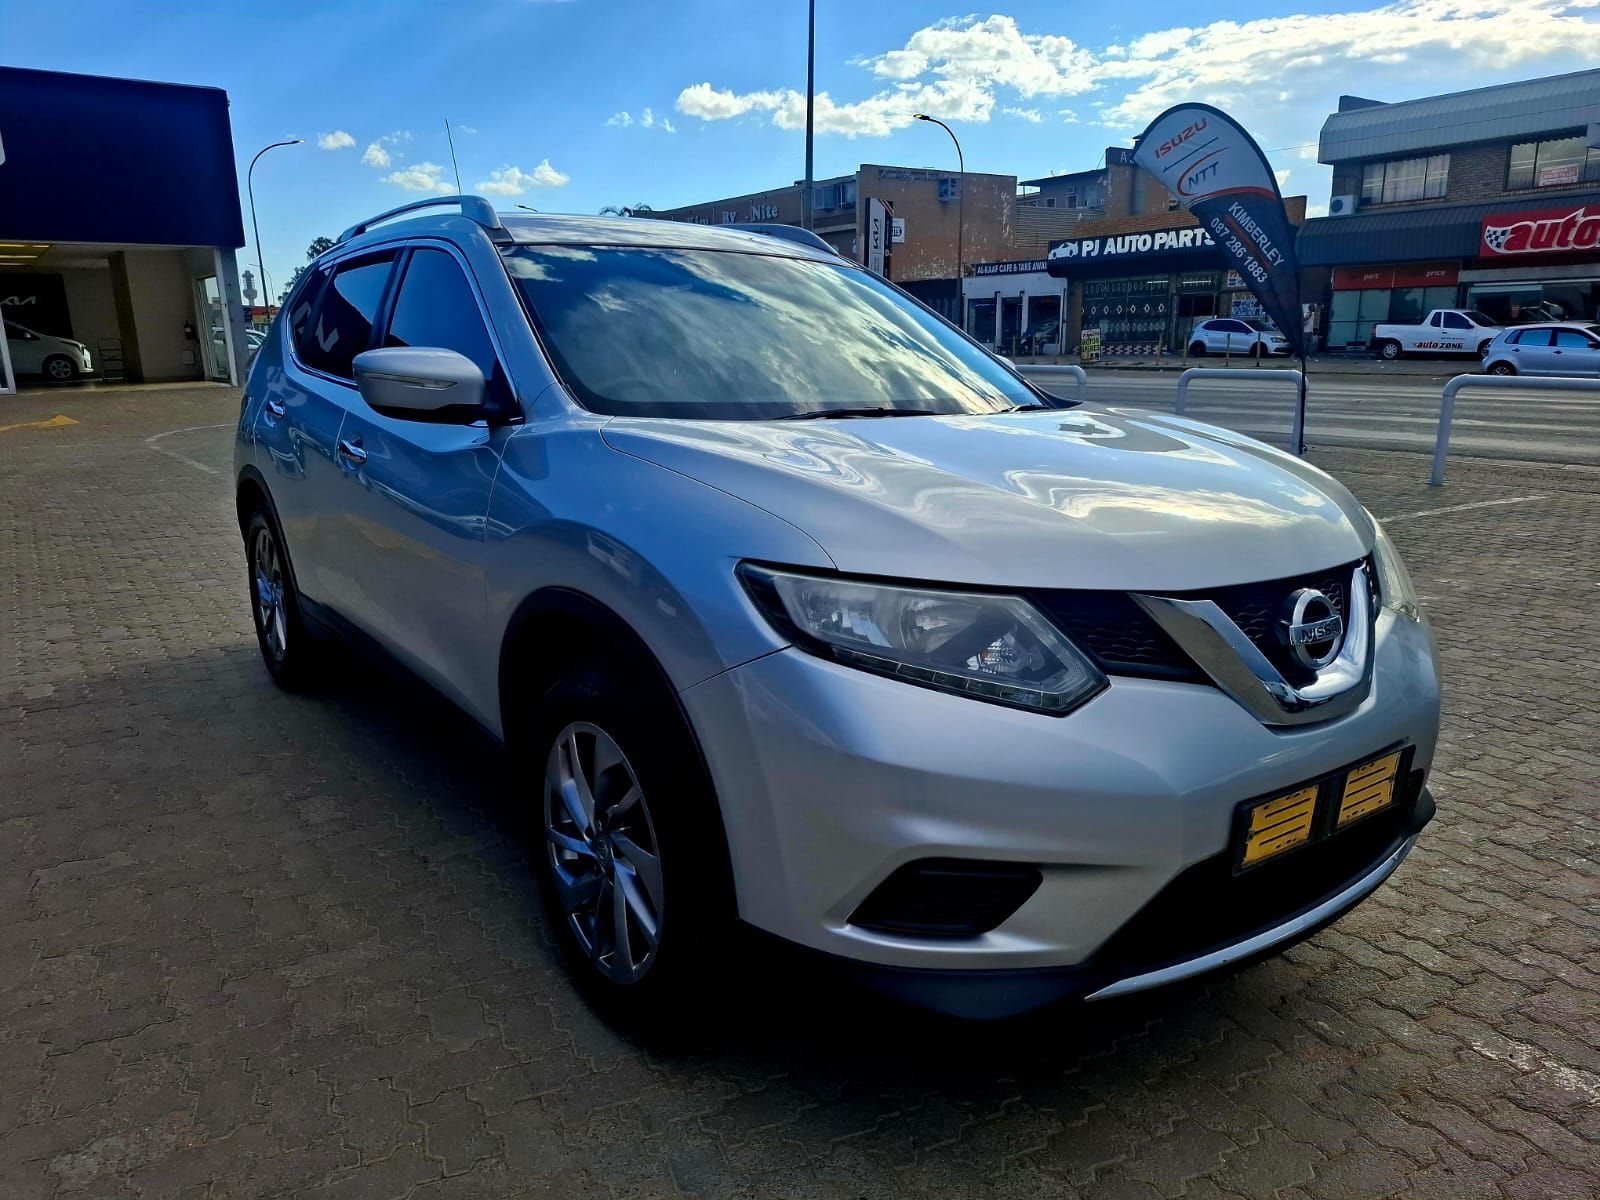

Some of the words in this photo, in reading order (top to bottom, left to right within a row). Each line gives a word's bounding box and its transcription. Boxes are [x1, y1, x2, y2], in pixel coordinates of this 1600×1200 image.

[1155, 117, 1208, 159] ISUZU
[1188, 161, 1219, 188] NTT
[751, 204, 778, 221] Nite
[1081, 239, 1100, 257] PJ
[1103, 233, 1152, 255] AUTO
[1228, 202, 1285, 266] KIMBERLEY
[1502, 208, 1600, 252] auto
[1210, 217, 1230, 237] 087
[1226, 236, 1247, 258] 286
[1243, 256, 1268, 283] 1883
[999, 263, 1012, 273] CAFE
